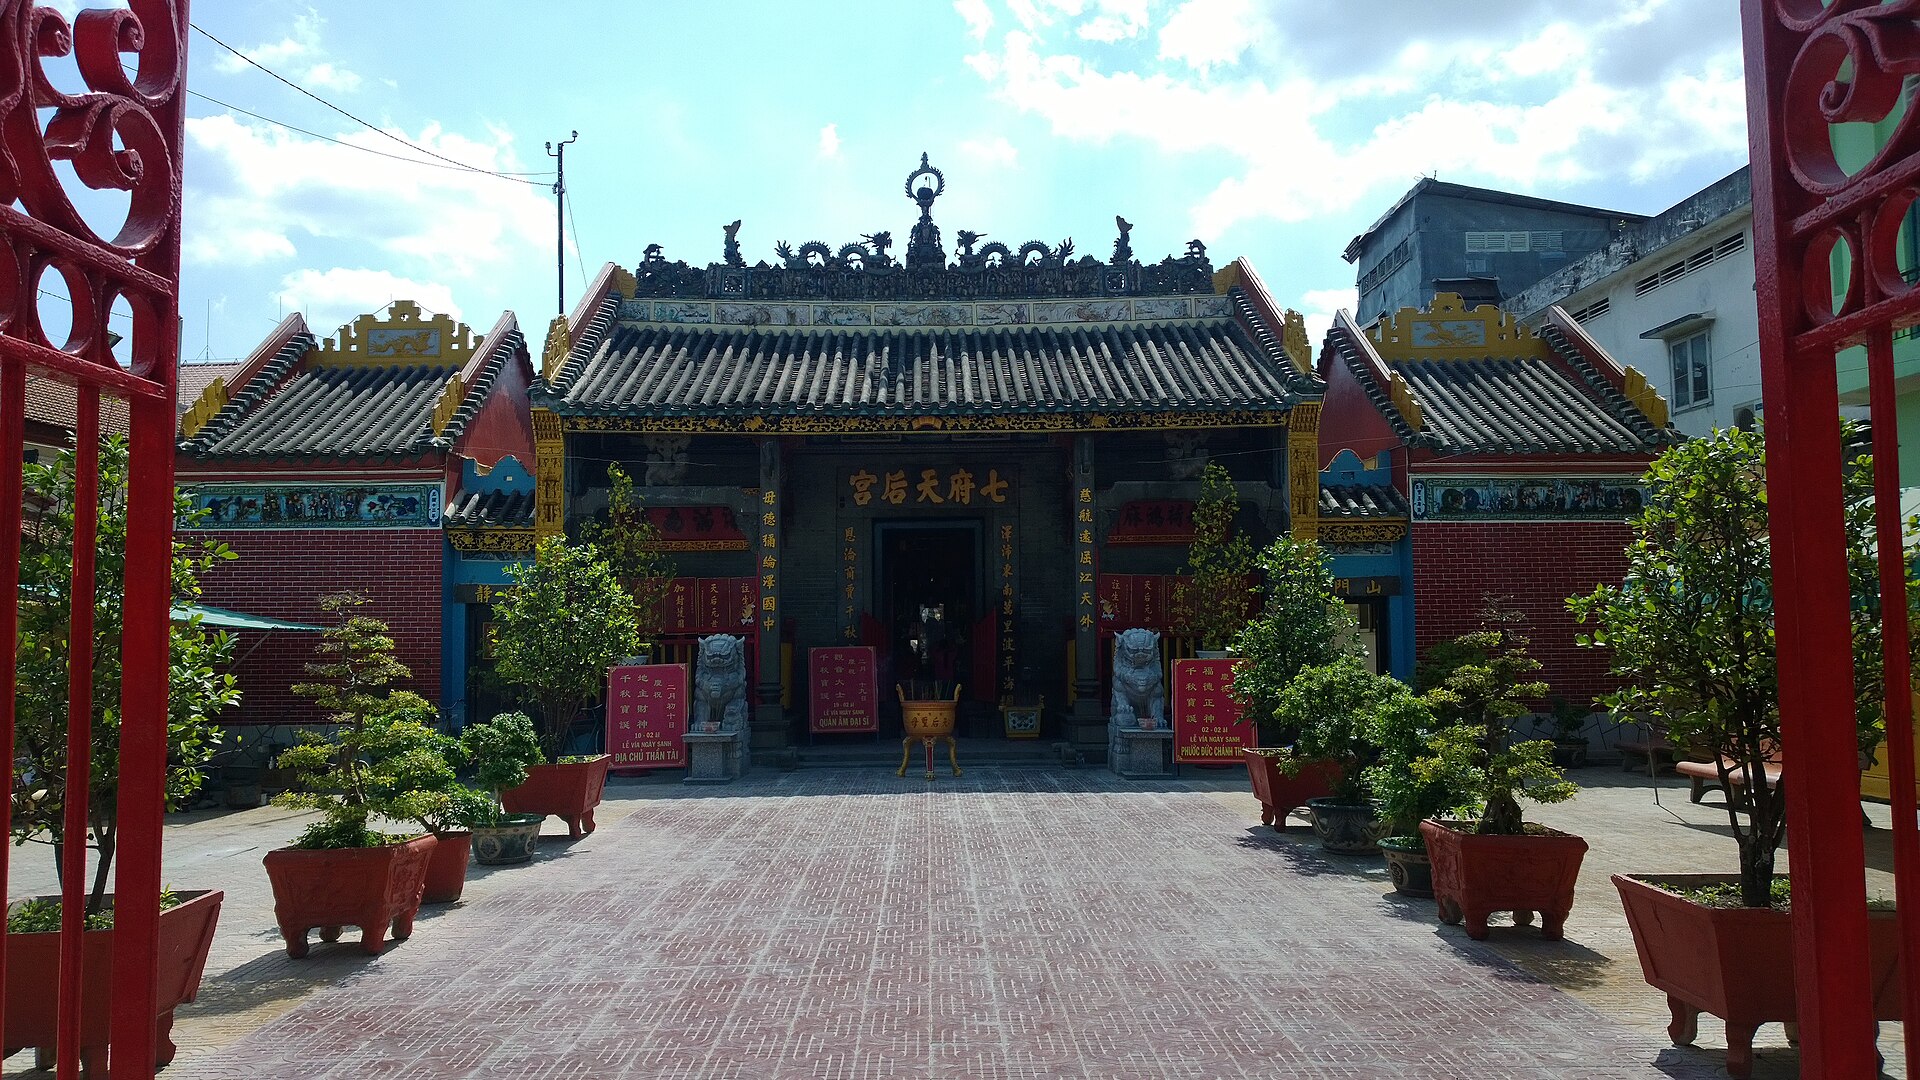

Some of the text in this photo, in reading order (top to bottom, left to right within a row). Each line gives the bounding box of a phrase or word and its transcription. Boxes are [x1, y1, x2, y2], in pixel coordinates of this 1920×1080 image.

[848, 467, 1009, 506] 七府天后宮
[843, 526, 857, 646] 恩洽商賈千秋
[619, 674, 631, 730] 千秋寶誕
[637, 674, 649, 729] 地主財神
[666, 684, 677, 729] 二月初十日
[1185, 666, 1198, 724] 千秋寶誕
[1202, 666, 1216, 724] 福德正神
[615, 752, 628, 764] ĐỊA
[628, 748, 644, 762] CHỦ
[666, 748, 679, 761] TÀI
[646, 731, 654, 739] 02
